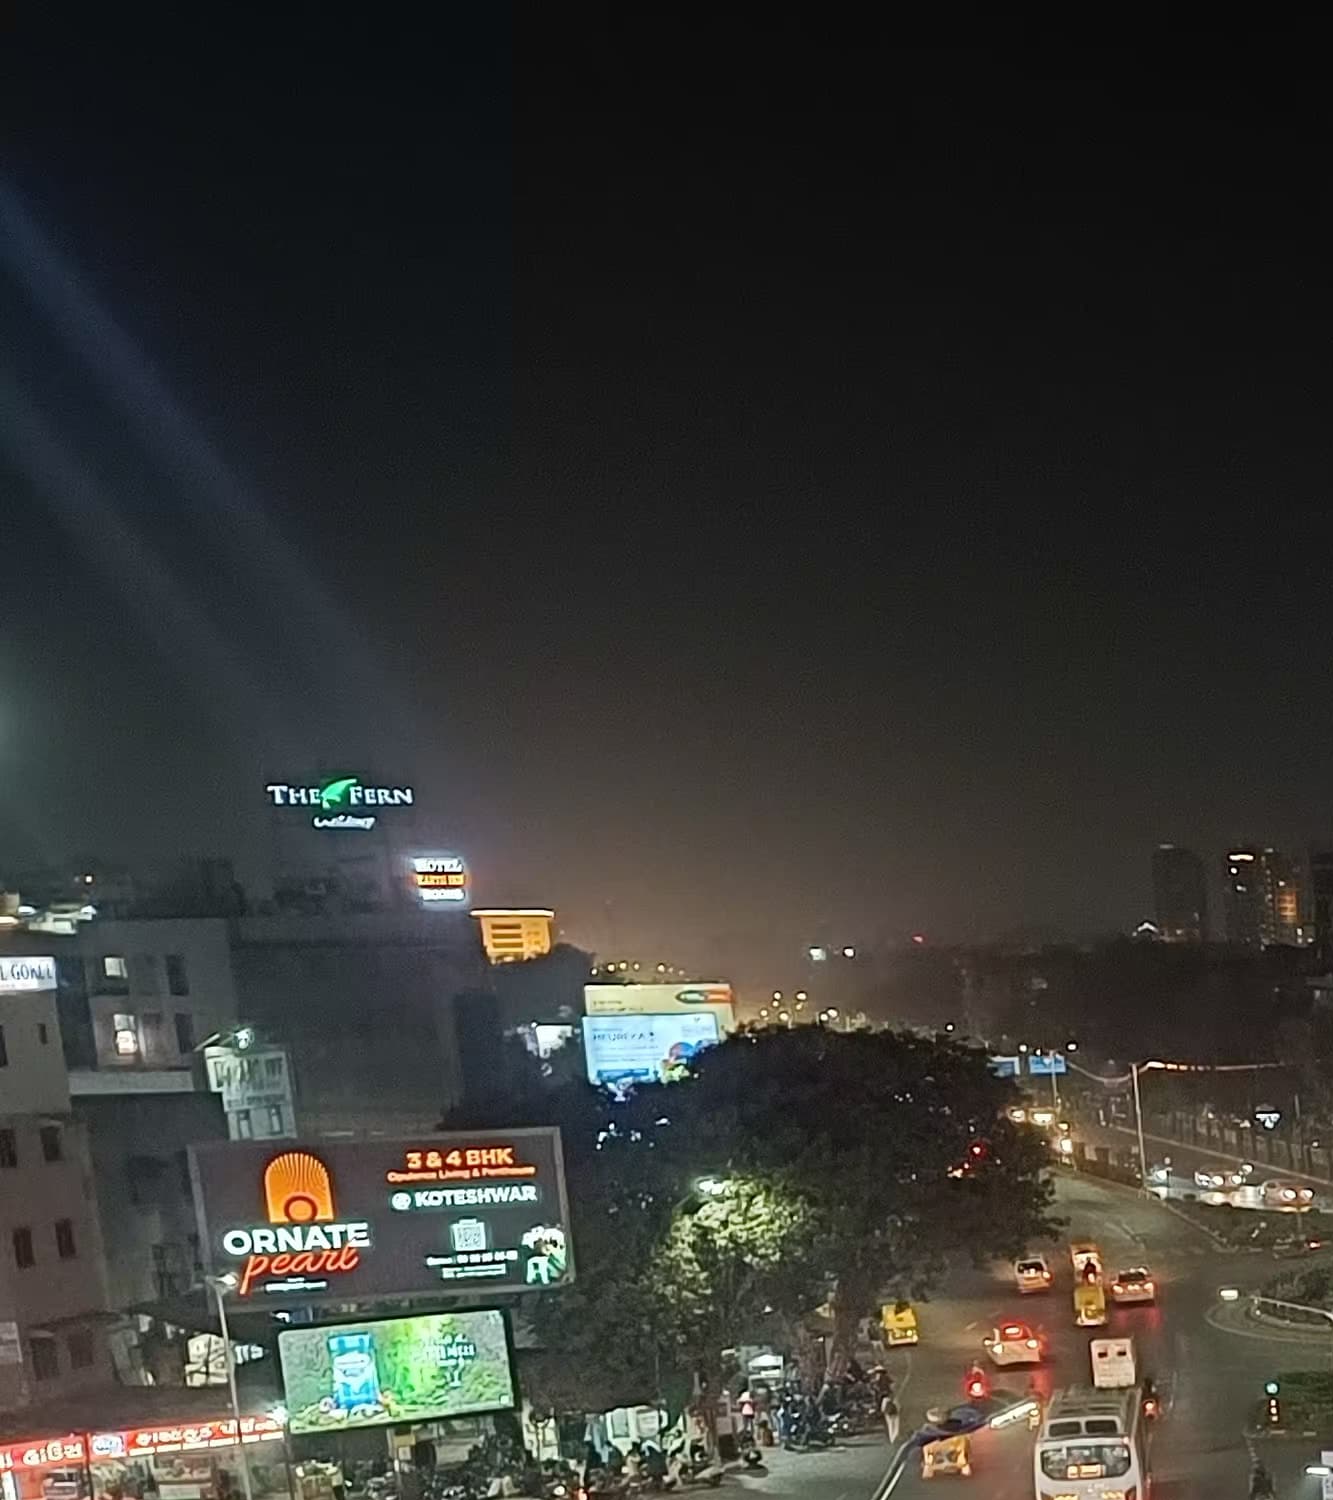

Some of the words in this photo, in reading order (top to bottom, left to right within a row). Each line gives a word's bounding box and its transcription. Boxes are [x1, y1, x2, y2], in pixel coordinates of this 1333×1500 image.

[267, 785, 321, 805] THE
[350, 786, 413, 805] FERN
[406, 1152, 422, 1169] 3
[426, 1151, 442, 1168] &
[445, 1150, 462, 1167] 4
[466, 1147, 514, 1166] BHK
[414, 1185, 538, 1208] KOTESHWAR
[223, 1222, 371, 1256] ORNATE
[239, 1246, 359, 1295] pearl
